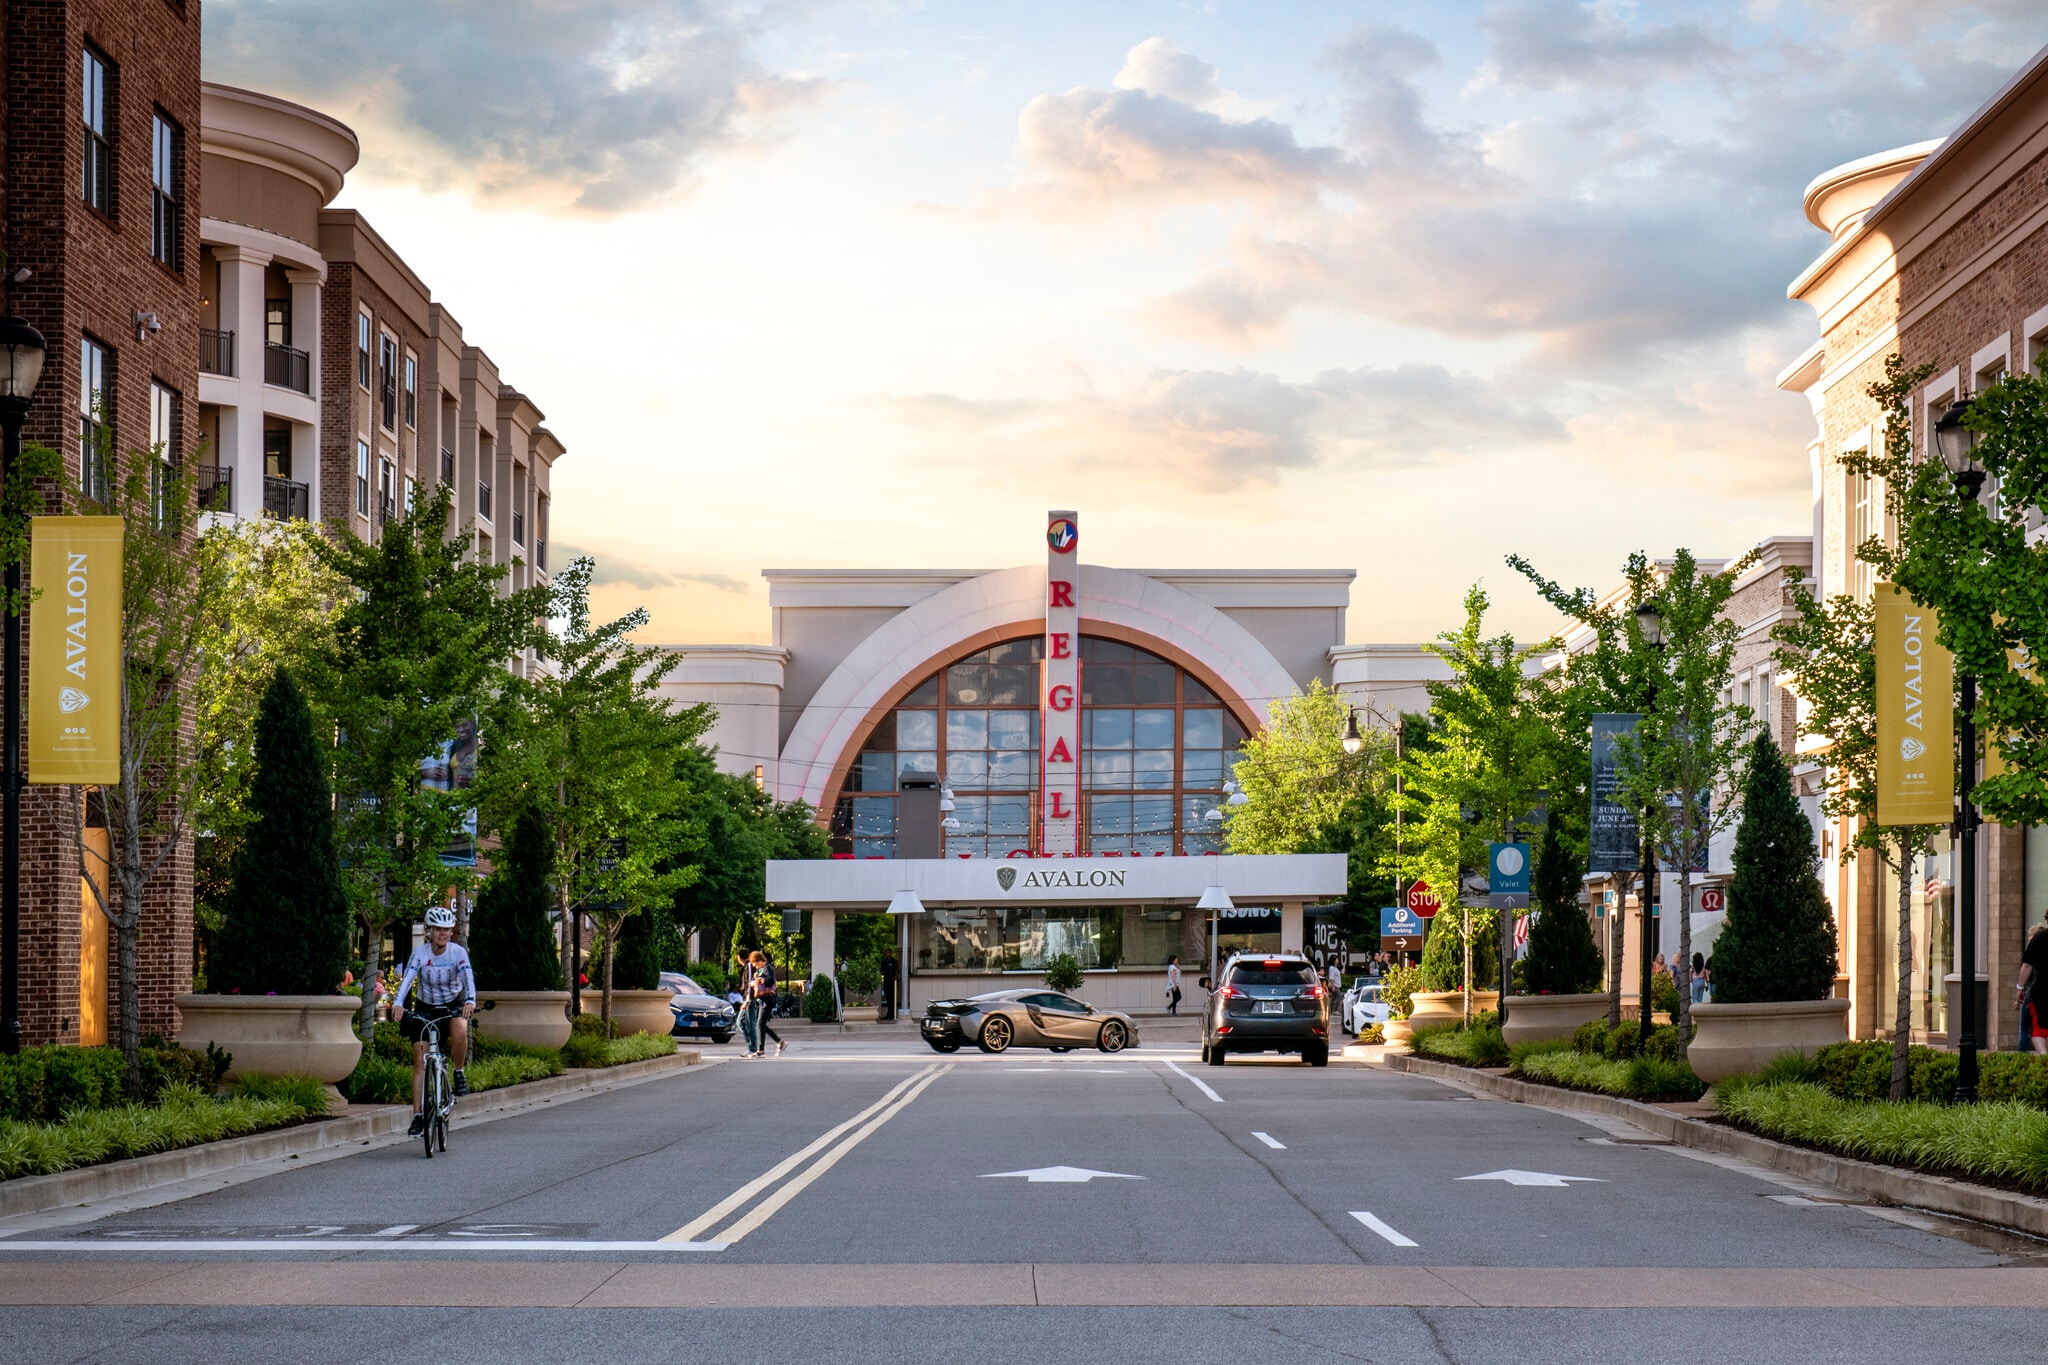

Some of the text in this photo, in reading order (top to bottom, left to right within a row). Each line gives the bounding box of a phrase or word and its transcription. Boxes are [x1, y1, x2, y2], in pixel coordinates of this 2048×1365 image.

[65, 551, 88, 680] AVALON
[1048, 580, 1076, 820] REGAL
[1904, 614, 1923, 731] AVALON
[1598, 806, 1630, 814] SUNDA
[1022, 869, 1127, 888] AVALON
[1499, 880, 1520, 888] Valet
